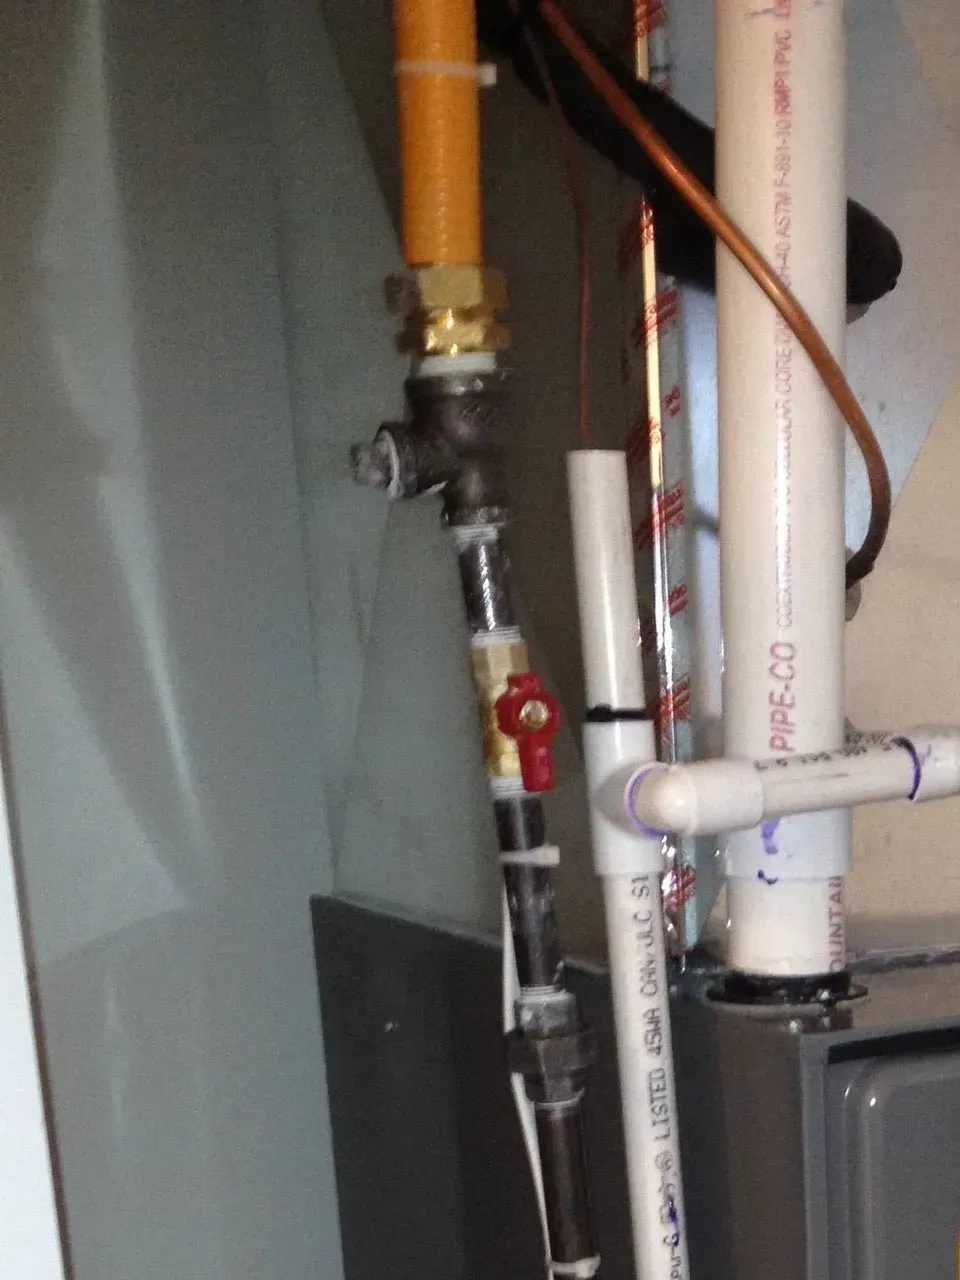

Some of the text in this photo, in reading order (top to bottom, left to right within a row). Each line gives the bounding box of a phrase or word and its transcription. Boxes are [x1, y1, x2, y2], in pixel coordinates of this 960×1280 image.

[774, 190, 792, 238] ASTM
[775, 347, 791, 394] CORE
[769, 641, 796, 753] PIPE-CO
[648, 1066, 671, 1141] LISTED
